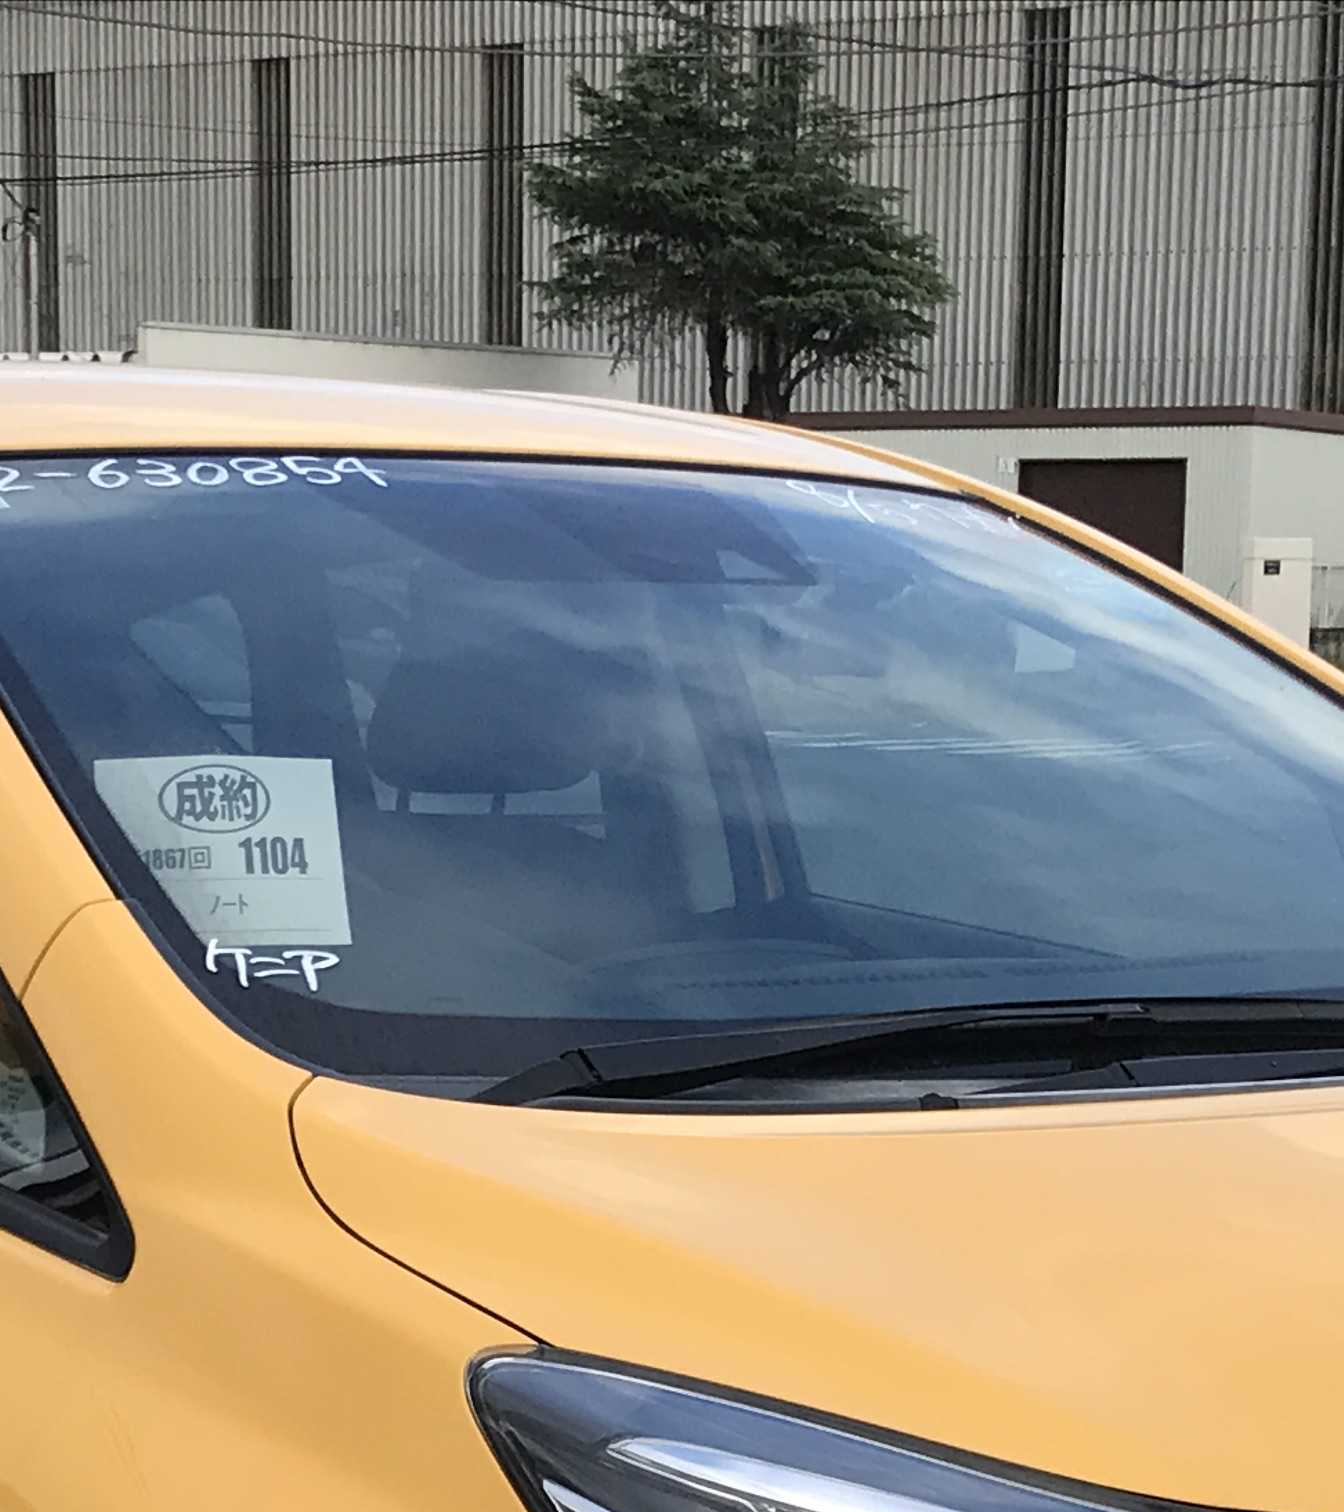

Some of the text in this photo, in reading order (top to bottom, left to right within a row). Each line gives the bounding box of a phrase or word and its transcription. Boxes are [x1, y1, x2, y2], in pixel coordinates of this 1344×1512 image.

[177, 773, 258, 822] 成約
[140, 836, 309, 875] 1867回 1104
[209, 894, 249, 915] ノート
